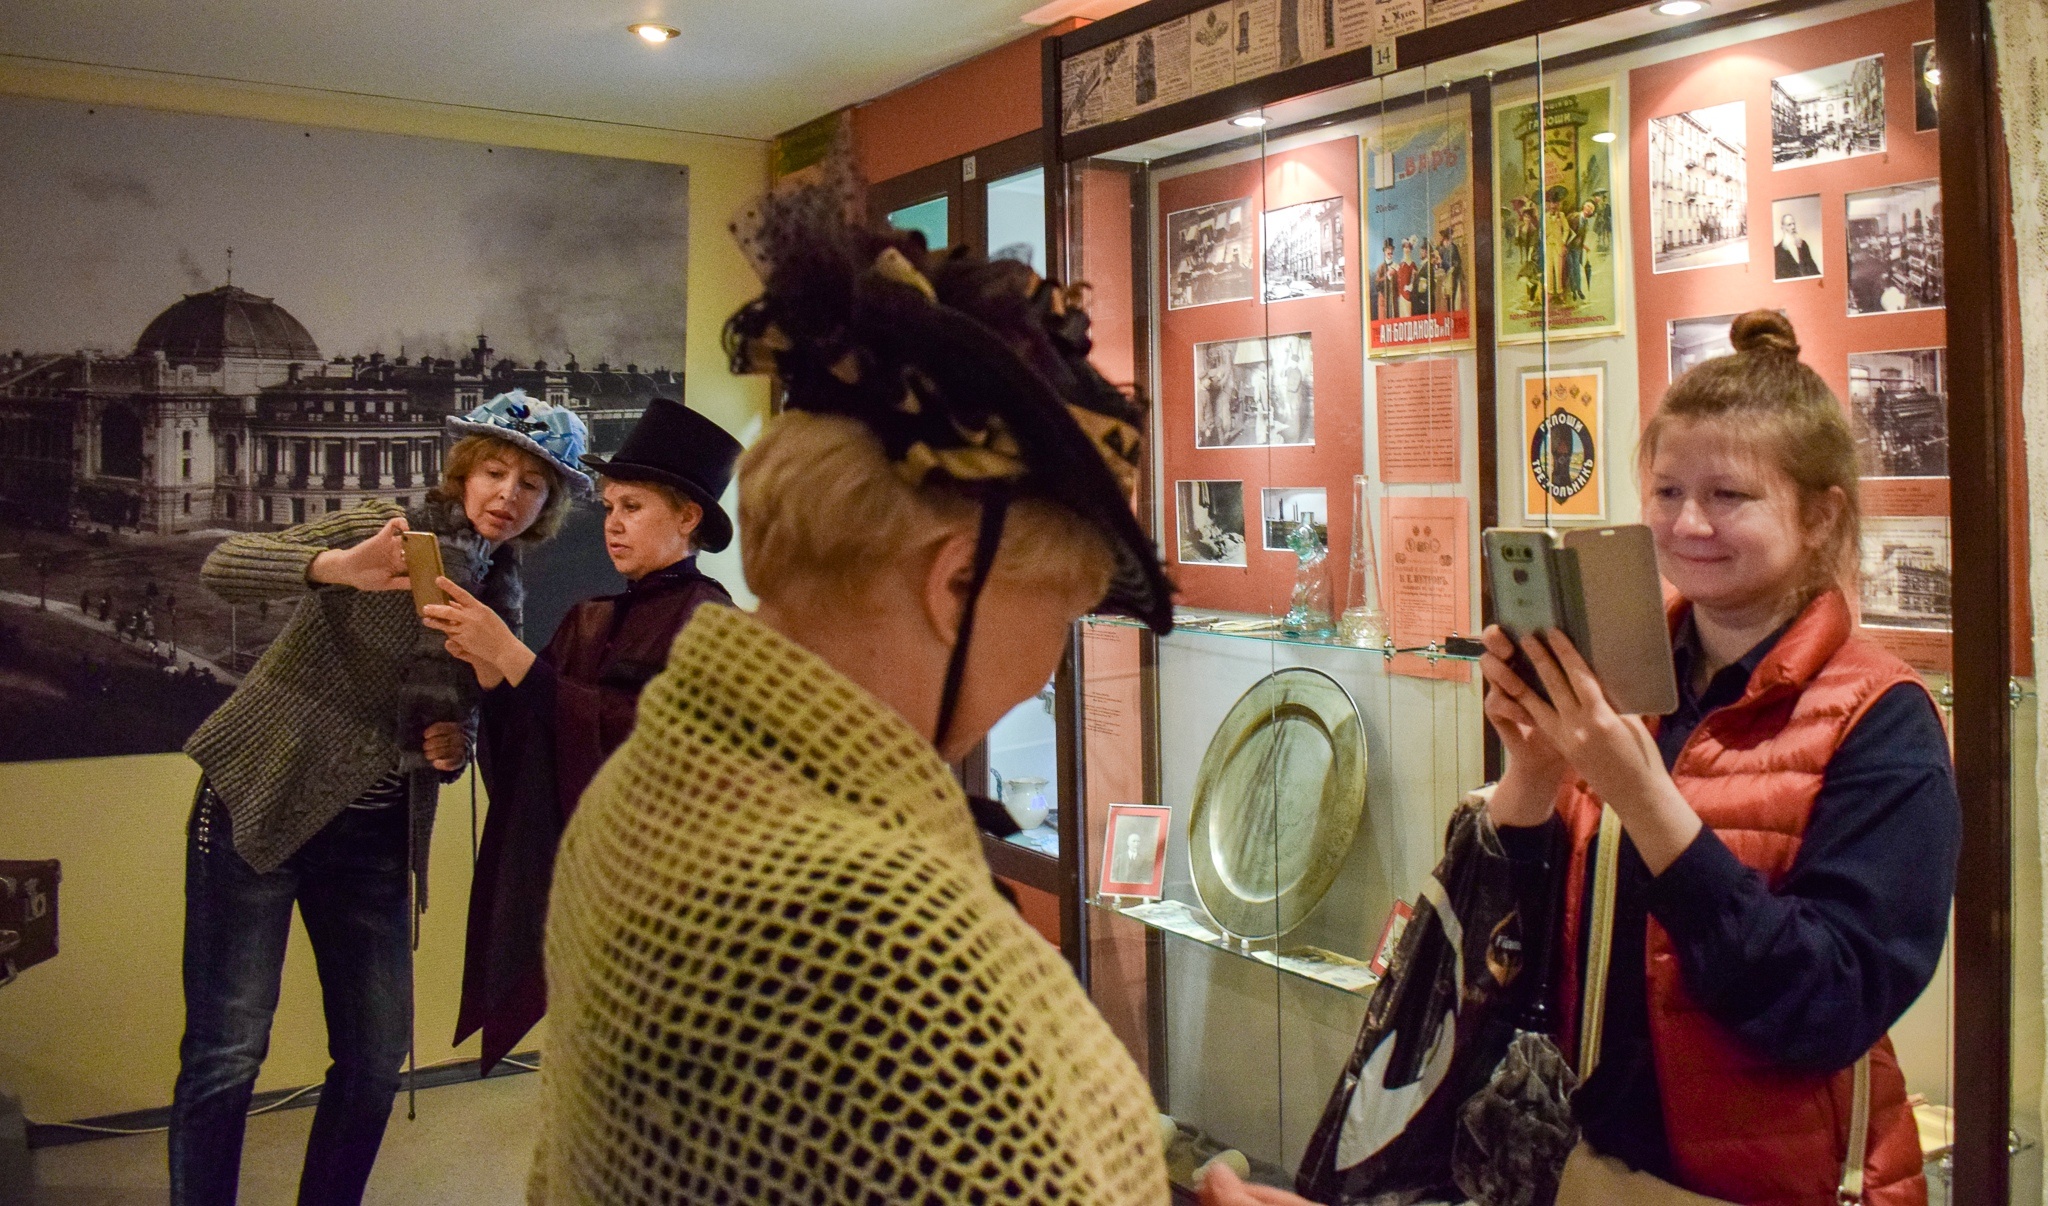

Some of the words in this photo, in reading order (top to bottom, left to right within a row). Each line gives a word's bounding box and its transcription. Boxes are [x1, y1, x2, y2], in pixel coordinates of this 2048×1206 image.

[1377, 46, 1391, 65] 14
[1528, 112, 1571, 131] ГАОШИ
[1540, 413, 1584, 433] ГАЛОШИ
